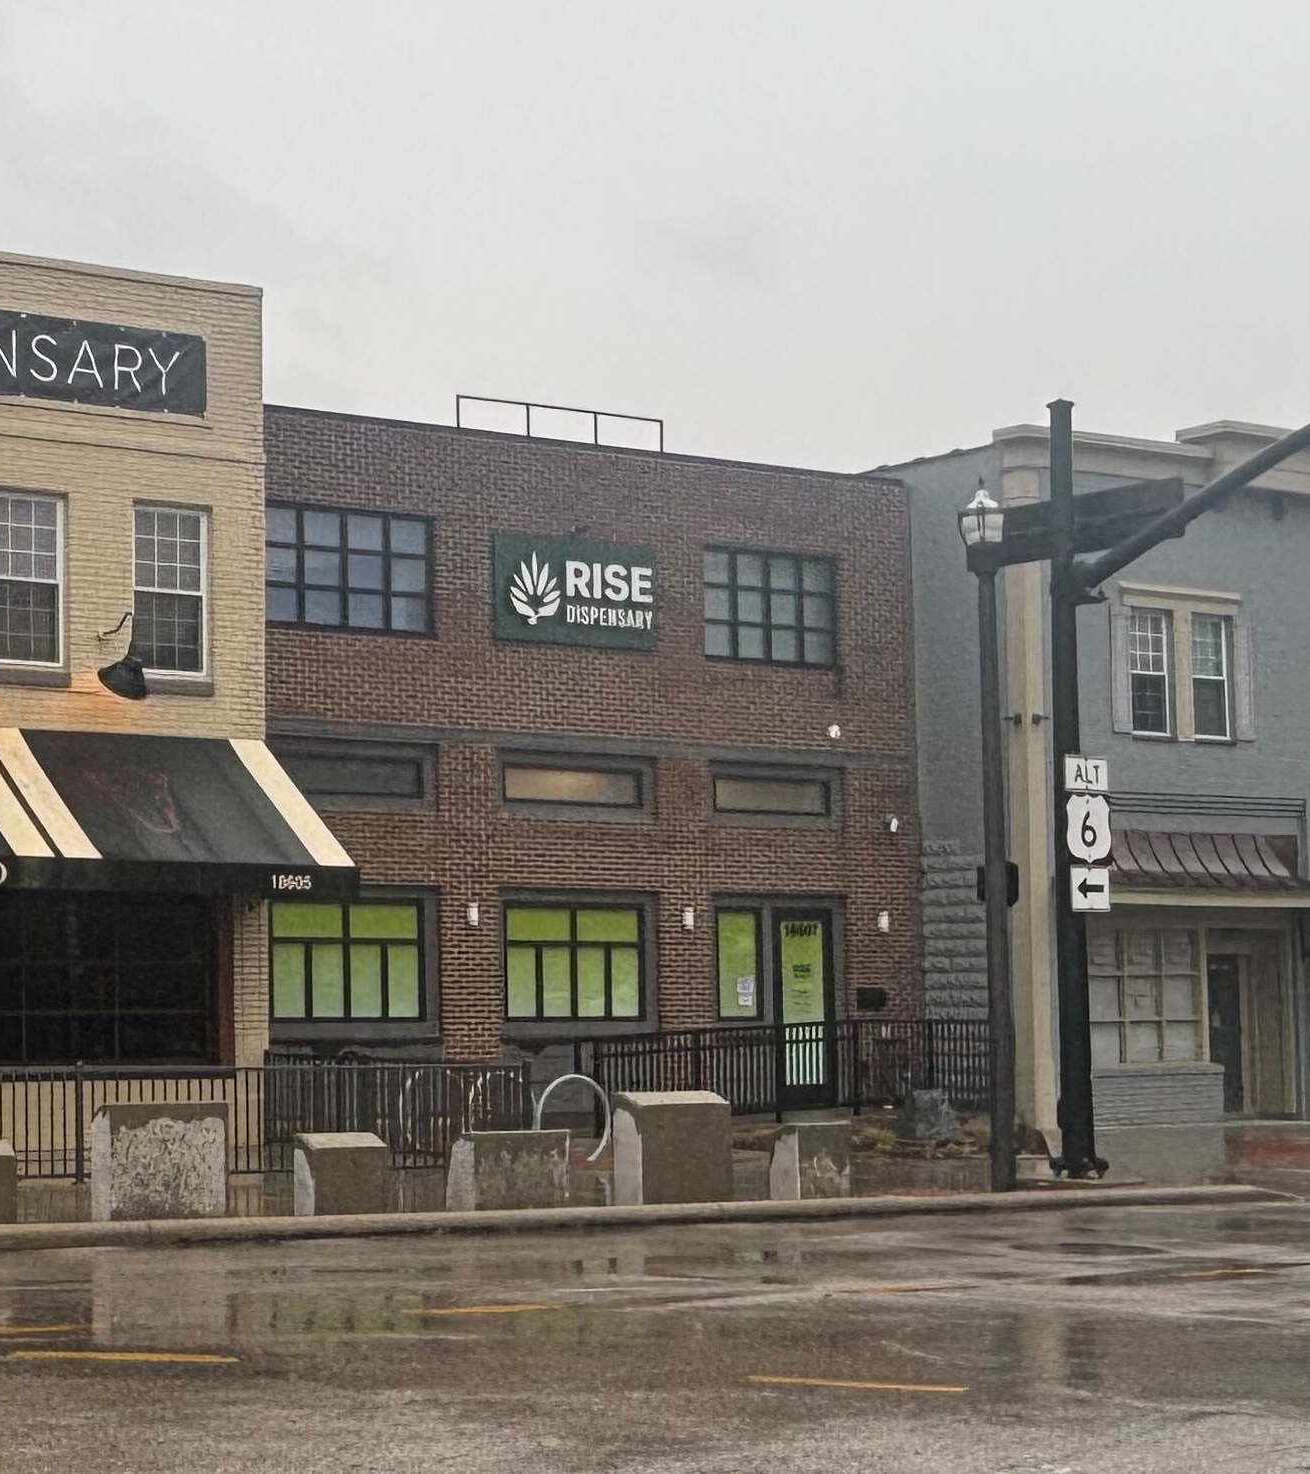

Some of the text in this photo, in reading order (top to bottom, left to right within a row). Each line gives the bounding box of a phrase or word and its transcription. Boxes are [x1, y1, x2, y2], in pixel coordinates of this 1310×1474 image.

[565, 560, 653, 603] RISE
[566, 604, 653, 630] DISPENSARY
[1074, 764, 1100, 785] ALT
[1081, 811, 1097, 847] 6
